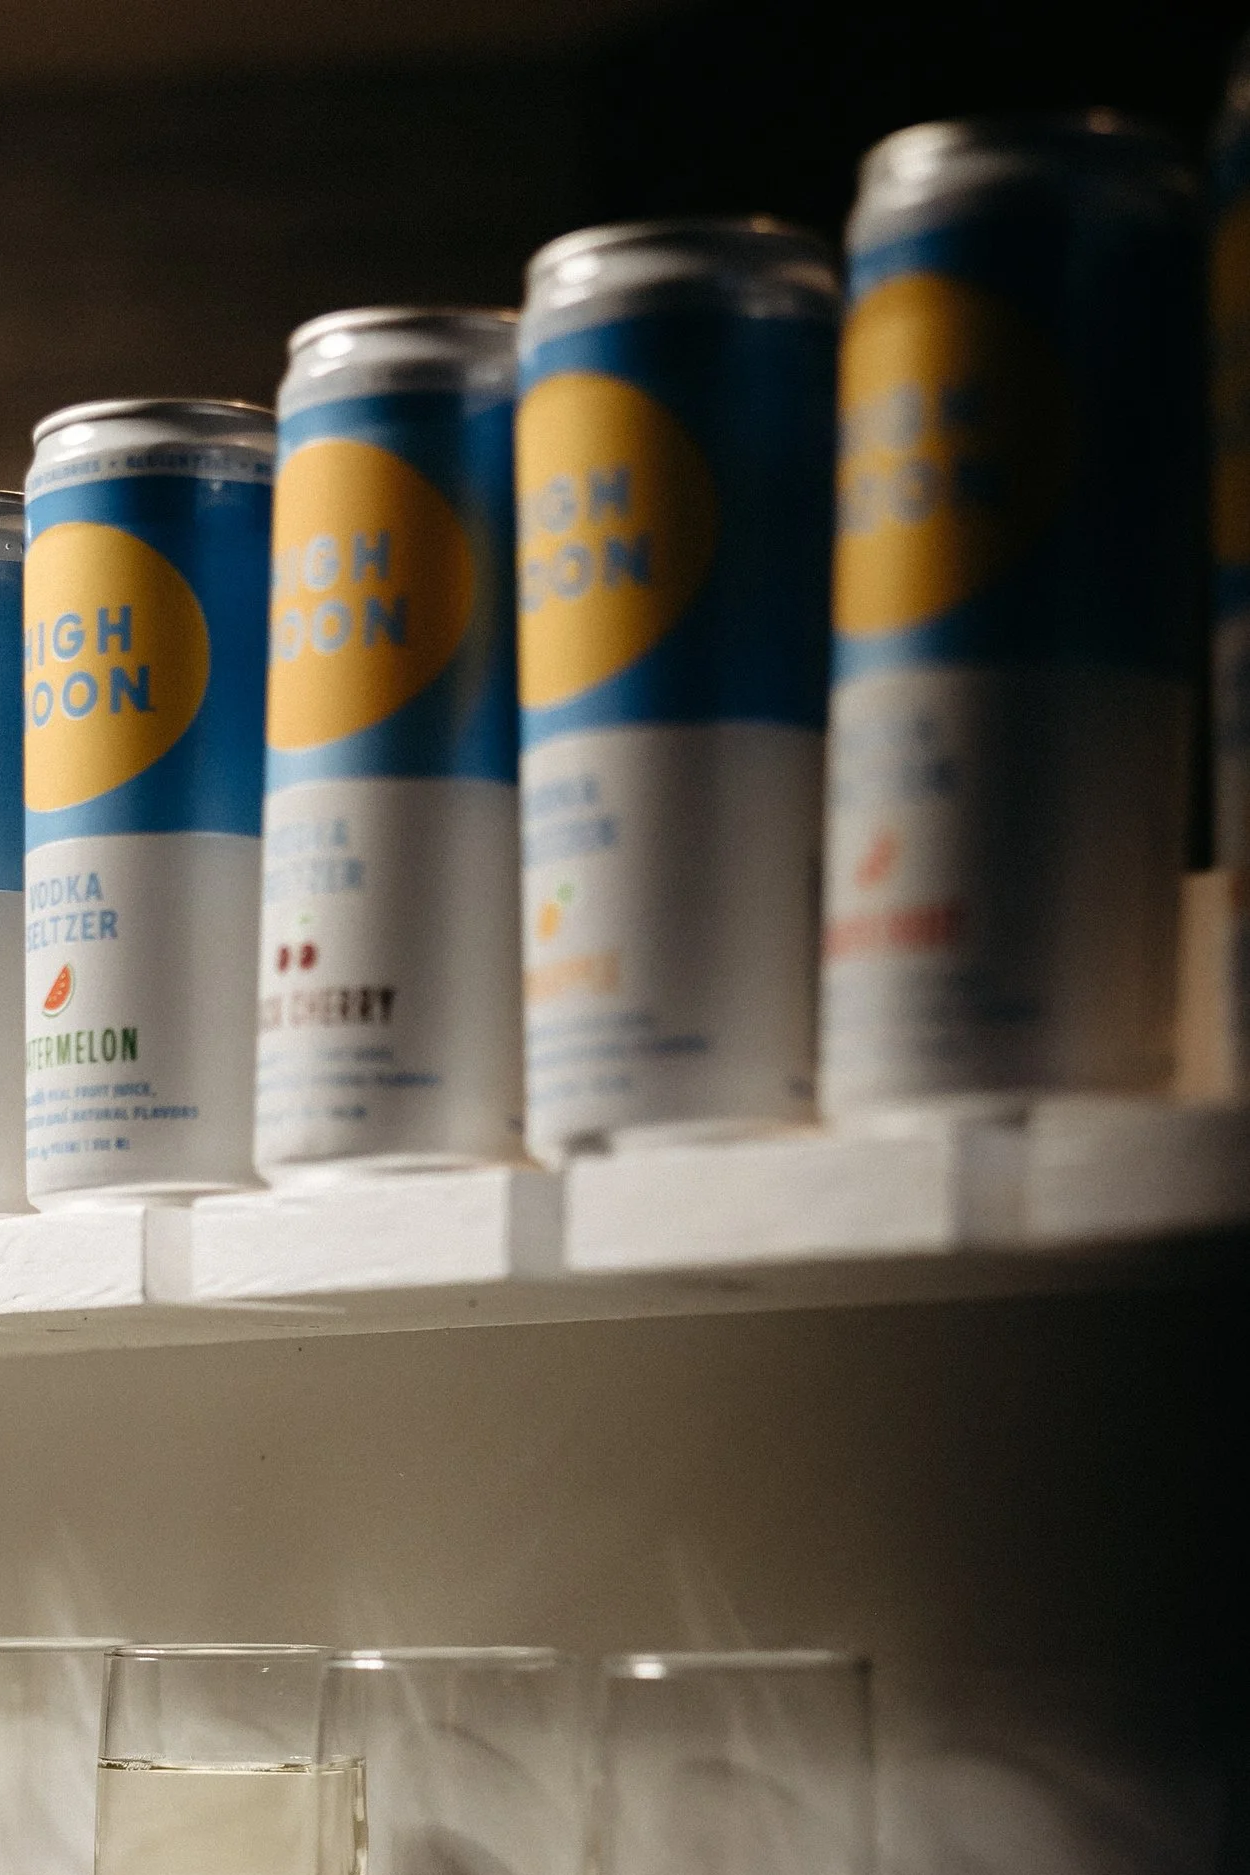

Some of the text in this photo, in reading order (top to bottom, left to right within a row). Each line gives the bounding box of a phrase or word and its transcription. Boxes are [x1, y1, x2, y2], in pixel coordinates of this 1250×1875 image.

[520, 534, 650, 616] OON
[275, 597, 409, 663] OON
[30, 665, 151, 729] OON
